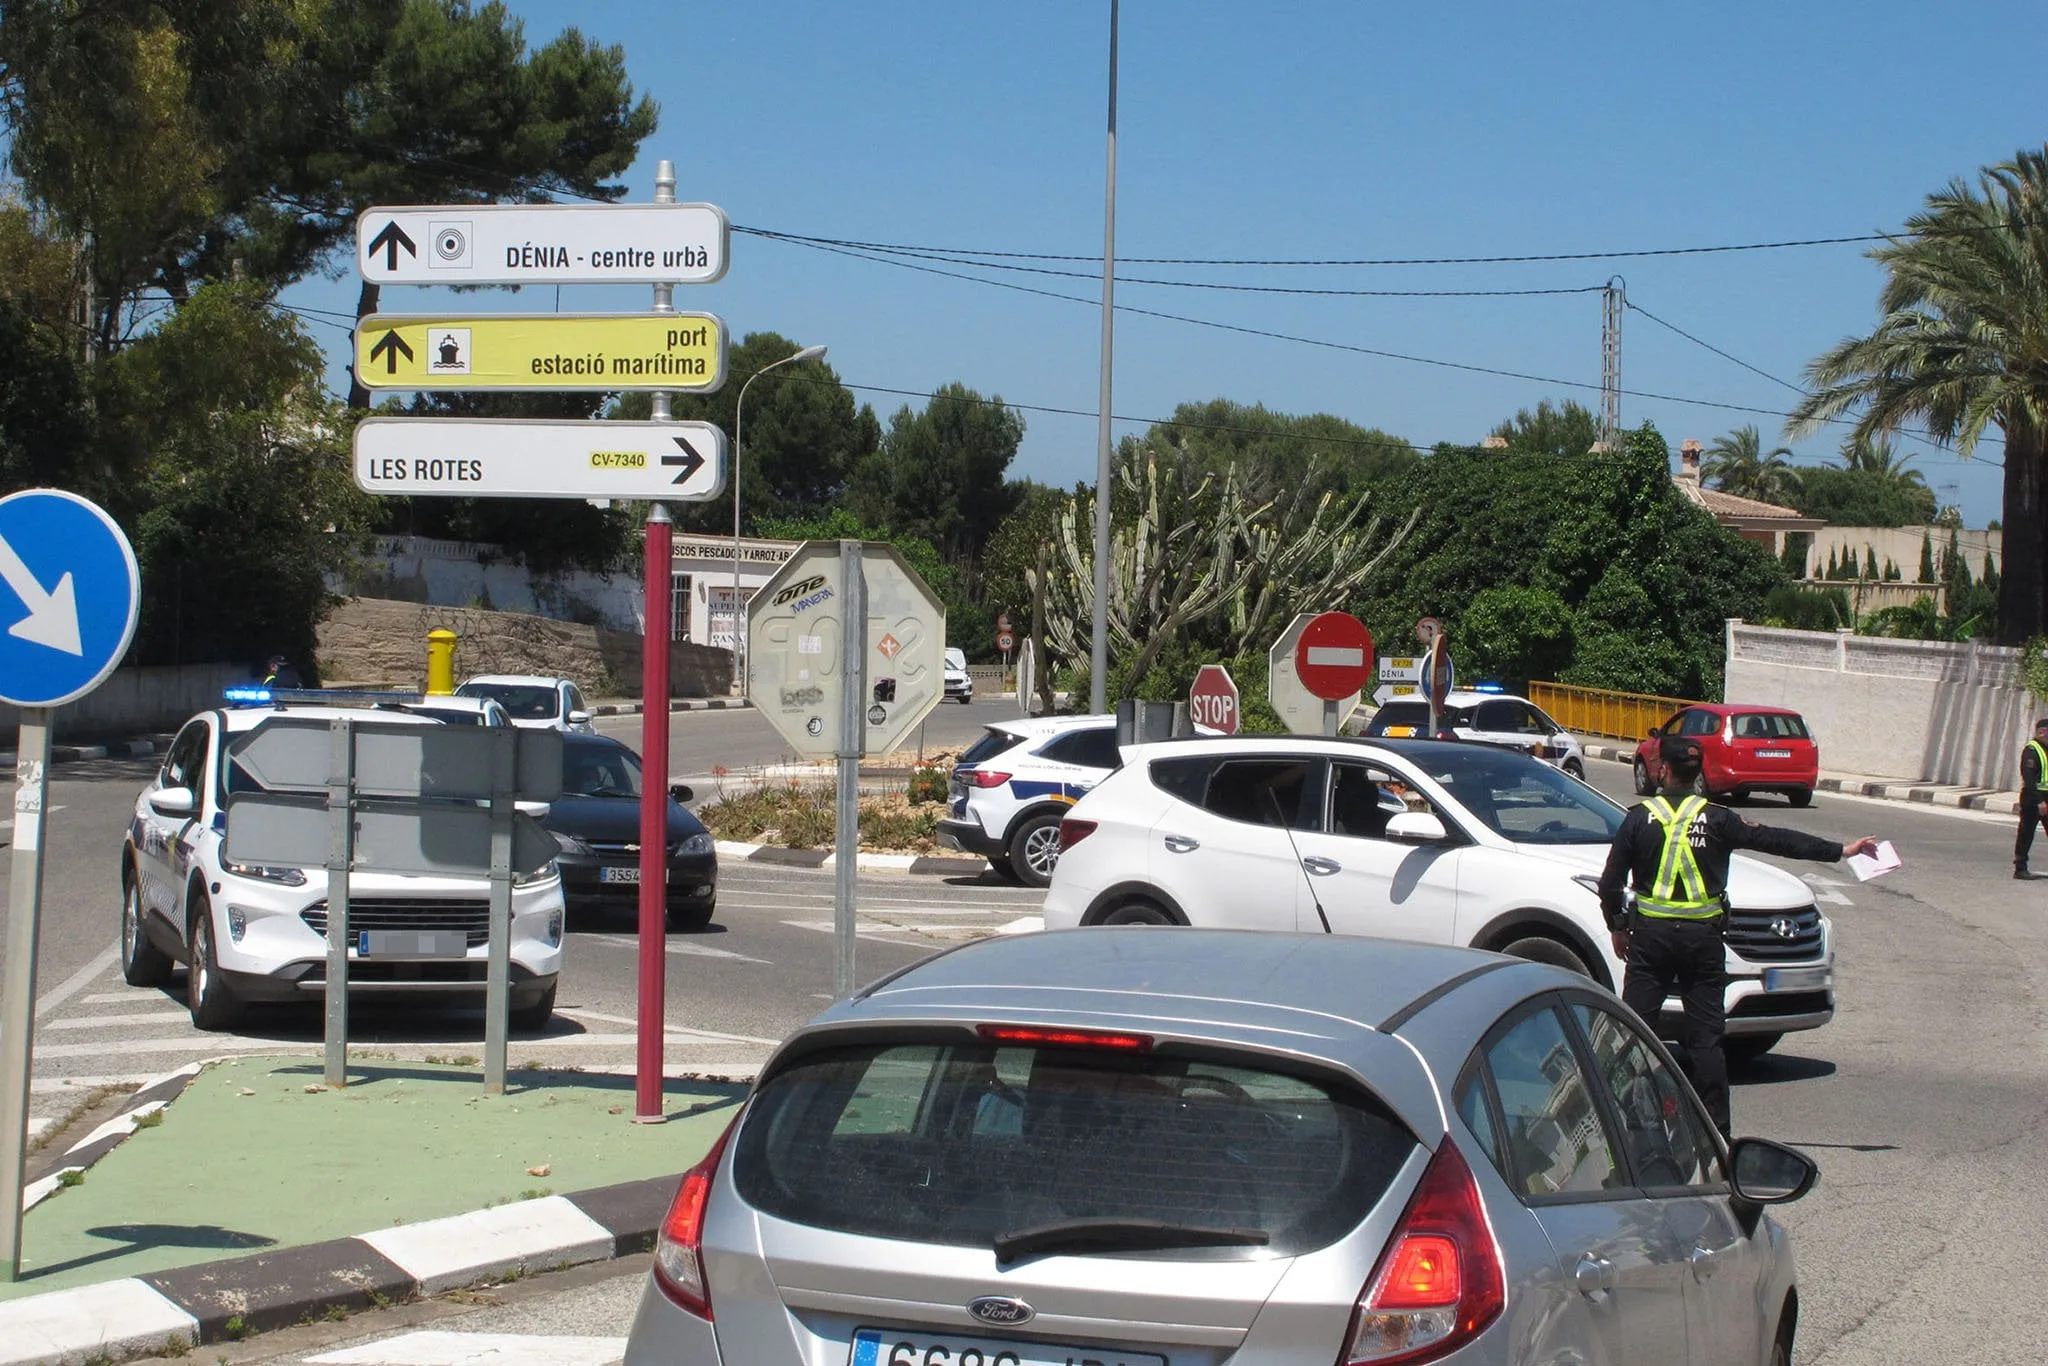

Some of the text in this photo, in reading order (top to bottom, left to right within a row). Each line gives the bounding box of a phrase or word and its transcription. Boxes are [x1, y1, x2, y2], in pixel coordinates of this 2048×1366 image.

[506, 242, 570, 268] DÉNIA
[591, 248, 656, 268] centre
[662, 245, 709, 268] urbà
[667, 327, 707, 352] port
[531, 352, 706, 376] estació marítima
[370, 458, 483, 482] LES ROTES
[591, 453, 645, 468] CV-7340
[1193, 695, 1234, 724] STOP
[1686, 825, 1707, 835] CAL
[1687, 836, 1707, 848] NIA
[980, 1301, 1018, 1322] Ford
